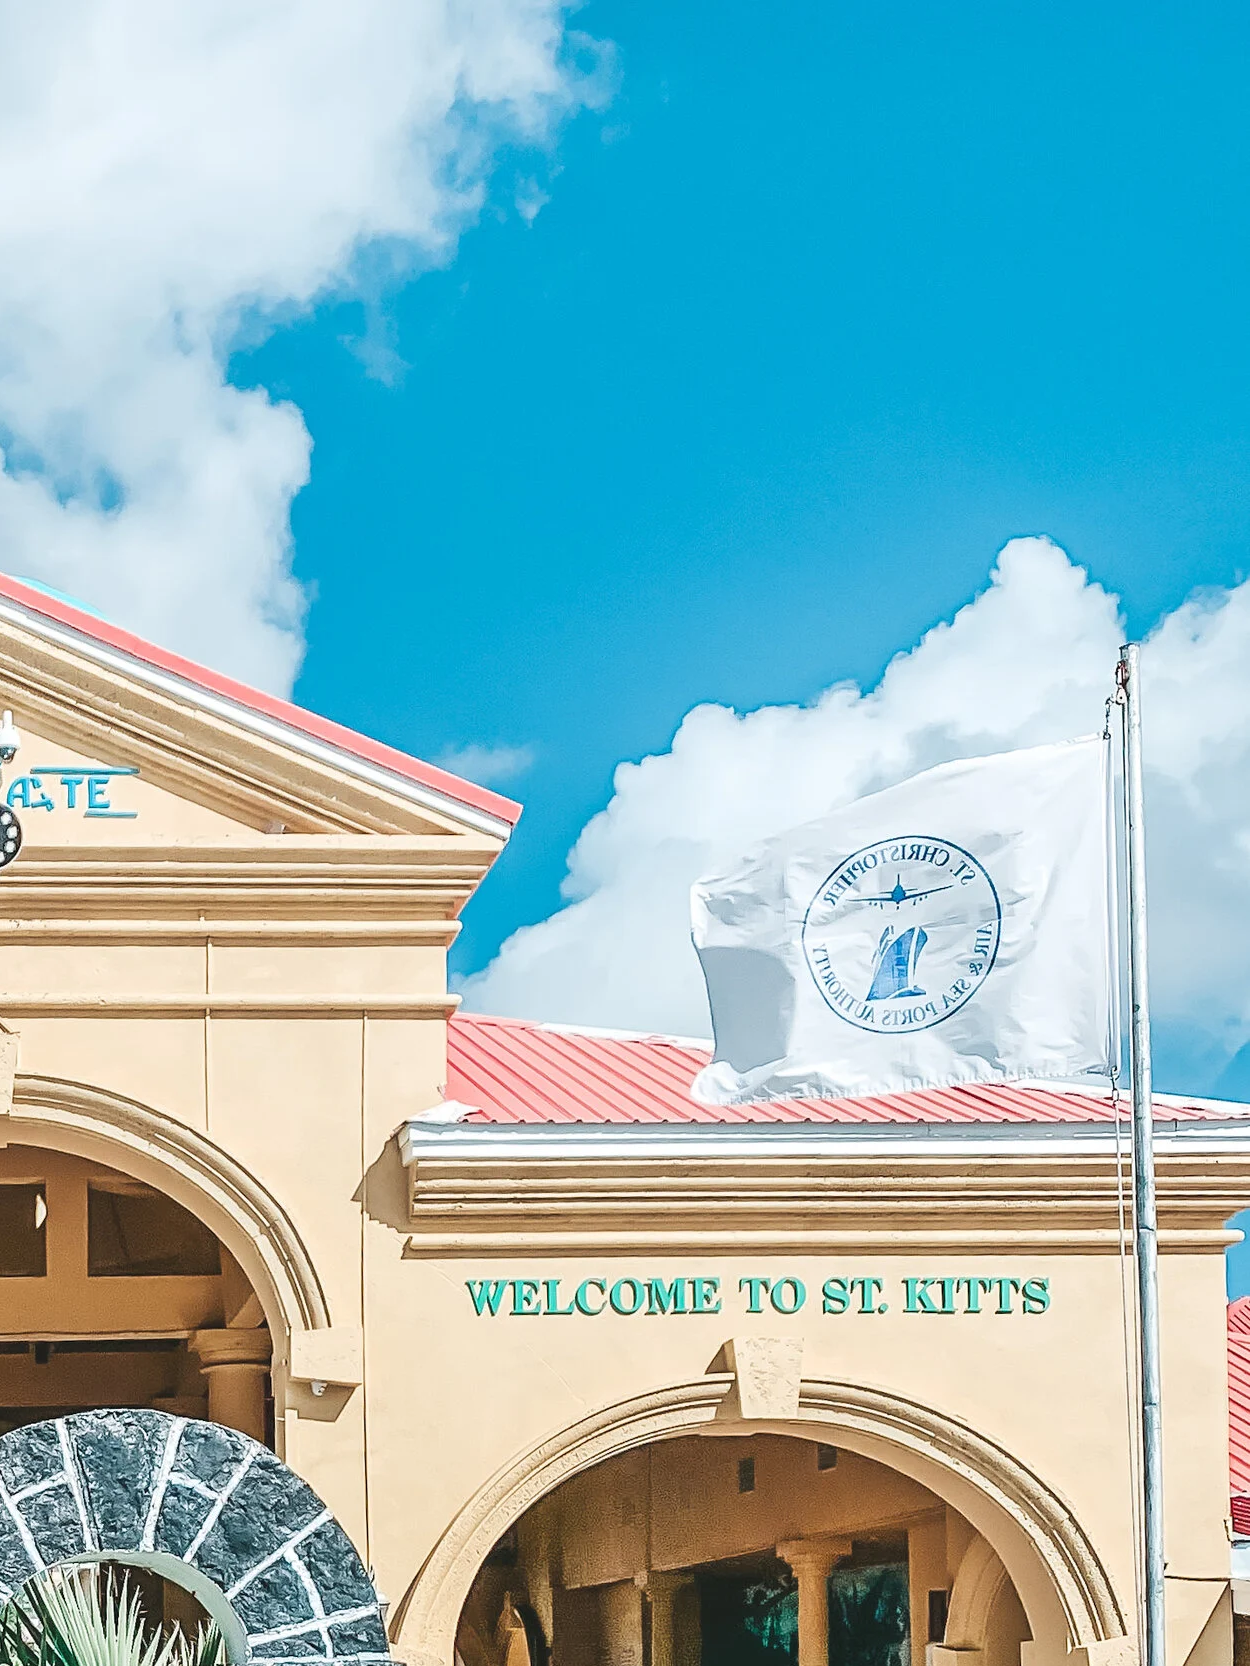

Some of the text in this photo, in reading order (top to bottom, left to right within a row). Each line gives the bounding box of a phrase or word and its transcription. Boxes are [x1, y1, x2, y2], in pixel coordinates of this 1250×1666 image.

[466, 1277, 1051, 1317] WELCOME TO ST. KITTS
